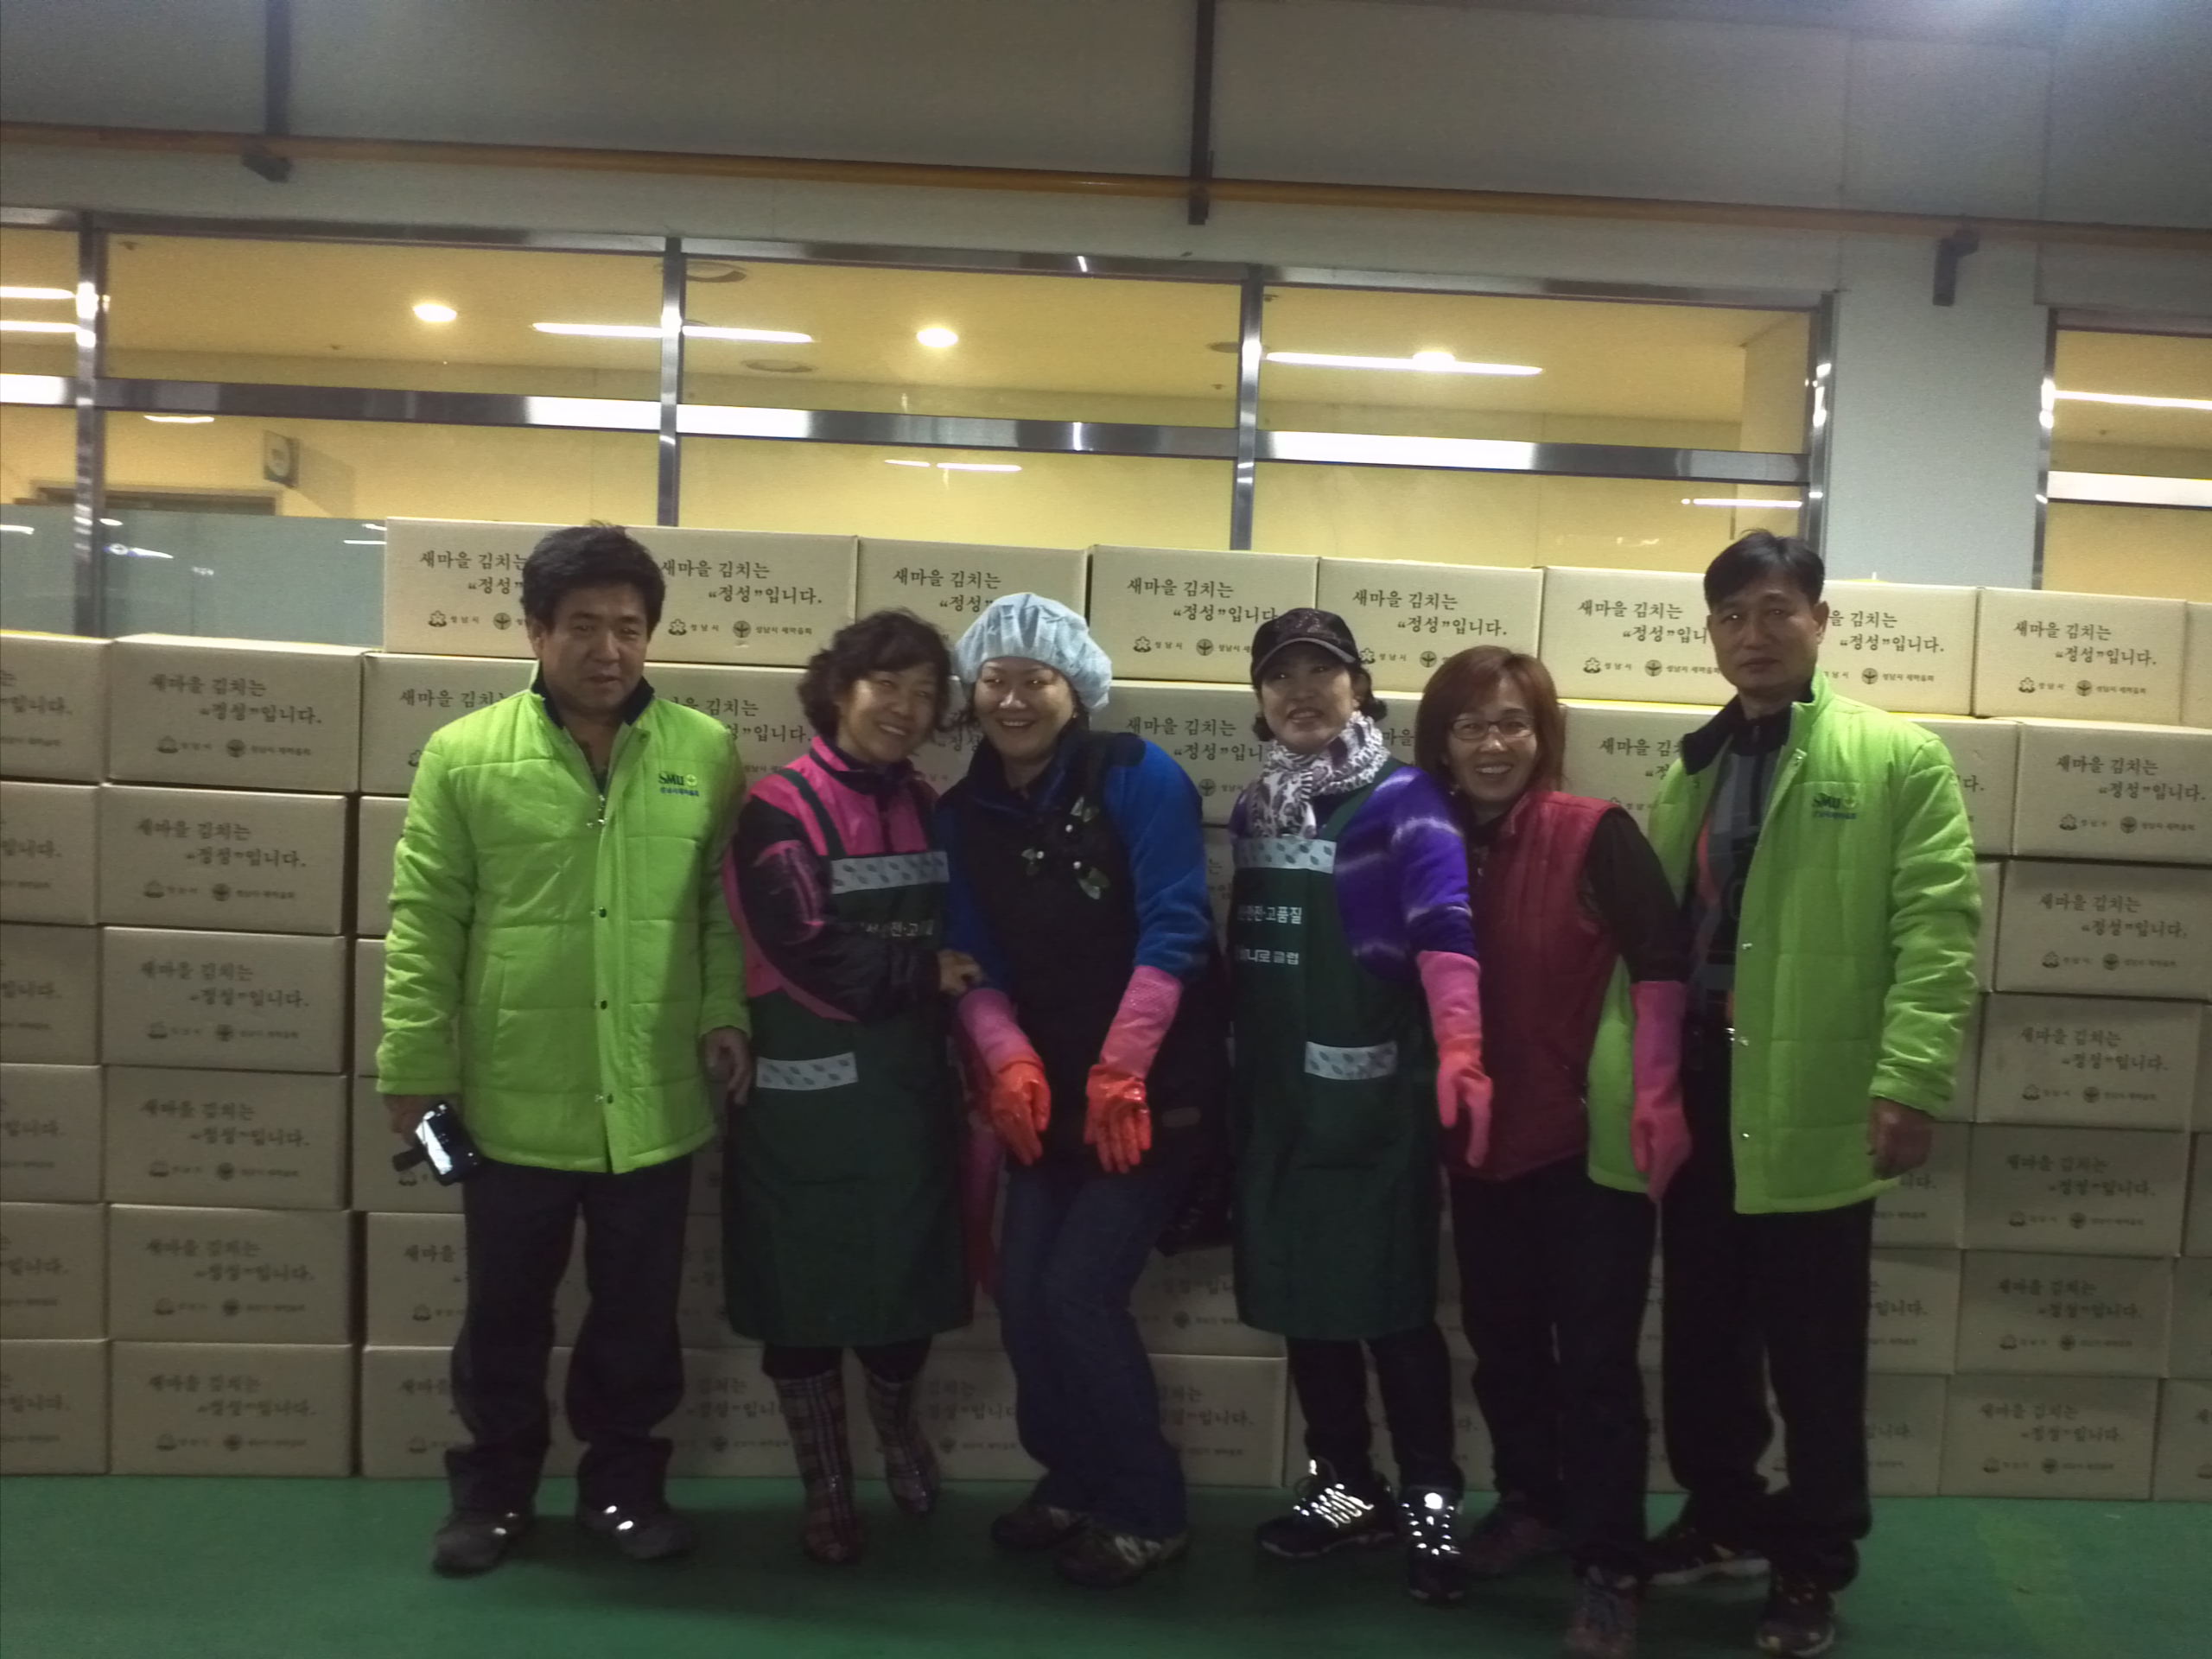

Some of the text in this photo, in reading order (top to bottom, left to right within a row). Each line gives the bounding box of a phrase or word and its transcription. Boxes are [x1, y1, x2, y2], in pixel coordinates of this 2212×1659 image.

[419, 550, 473, 569] 새마을
[662, 559, 771, 580] 새마을 김치는
[467, 576, 524, 594] “정성”
[893, 567, 1002, 589] 새마을 김치는
[1127, 577, 1234, 599] 새마을 김치는
[708, 584, 823, 604] “정성”입니다.
[939, 594, 993, 613] “정성”
[1352, 589, 1459, 611] 새마을 김치는
[1173, 604, 1278, 623] “정성”입니다
[1578, 599, 1683, 620] 새마을 김치는
[1850, 611, 1897, 629] 김치는
[1397, 615, 1508, 637] “정성”입니다.
[1623, 625, 1707, 645] “정성”입니
[2014, 620, 2112, 641] 새마을 김치는
[1840, 633, 1945, 653] “정성”입니다.
[2055, 645, 2158, 666] “정성”입니다.
[399, 688, 508, 709] 새마을 김치
[706, 698, 760, 717] 김치는
[1125, 716, 1236, 737] 새마을 김치는
[1382, 729, 1414, 747] 마을
[1599, 736, 1649, 756] 새마을
[1174, 741, 1263, 762] “정성”입니
[2056, 754, 2158, 777] 새마을 김치는
